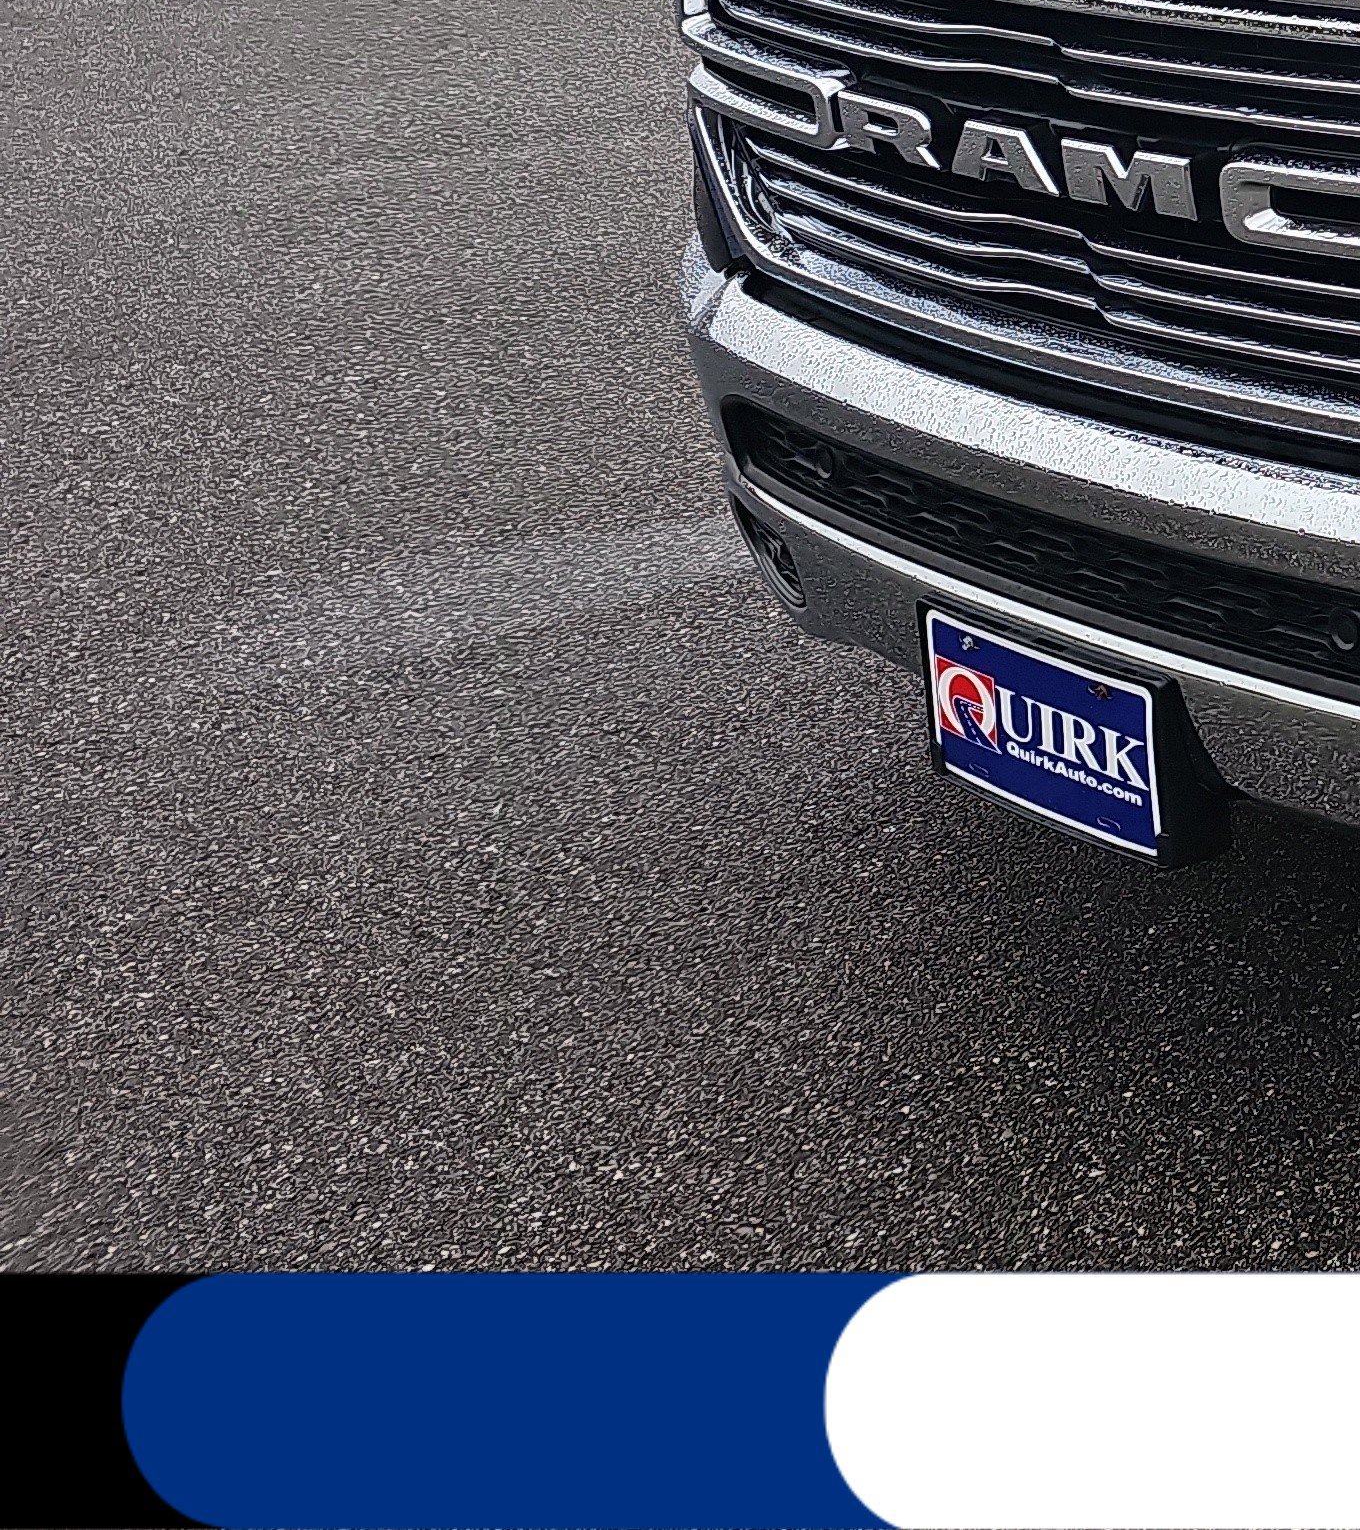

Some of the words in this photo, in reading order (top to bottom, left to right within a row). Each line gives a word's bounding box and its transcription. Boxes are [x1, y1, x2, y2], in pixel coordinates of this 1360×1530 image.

[836, 89, 1199, 221] RAM
[936, 660, 1150, 792] QUIRK
[1005, 740, 1143, 808] QuirkAuto.com
